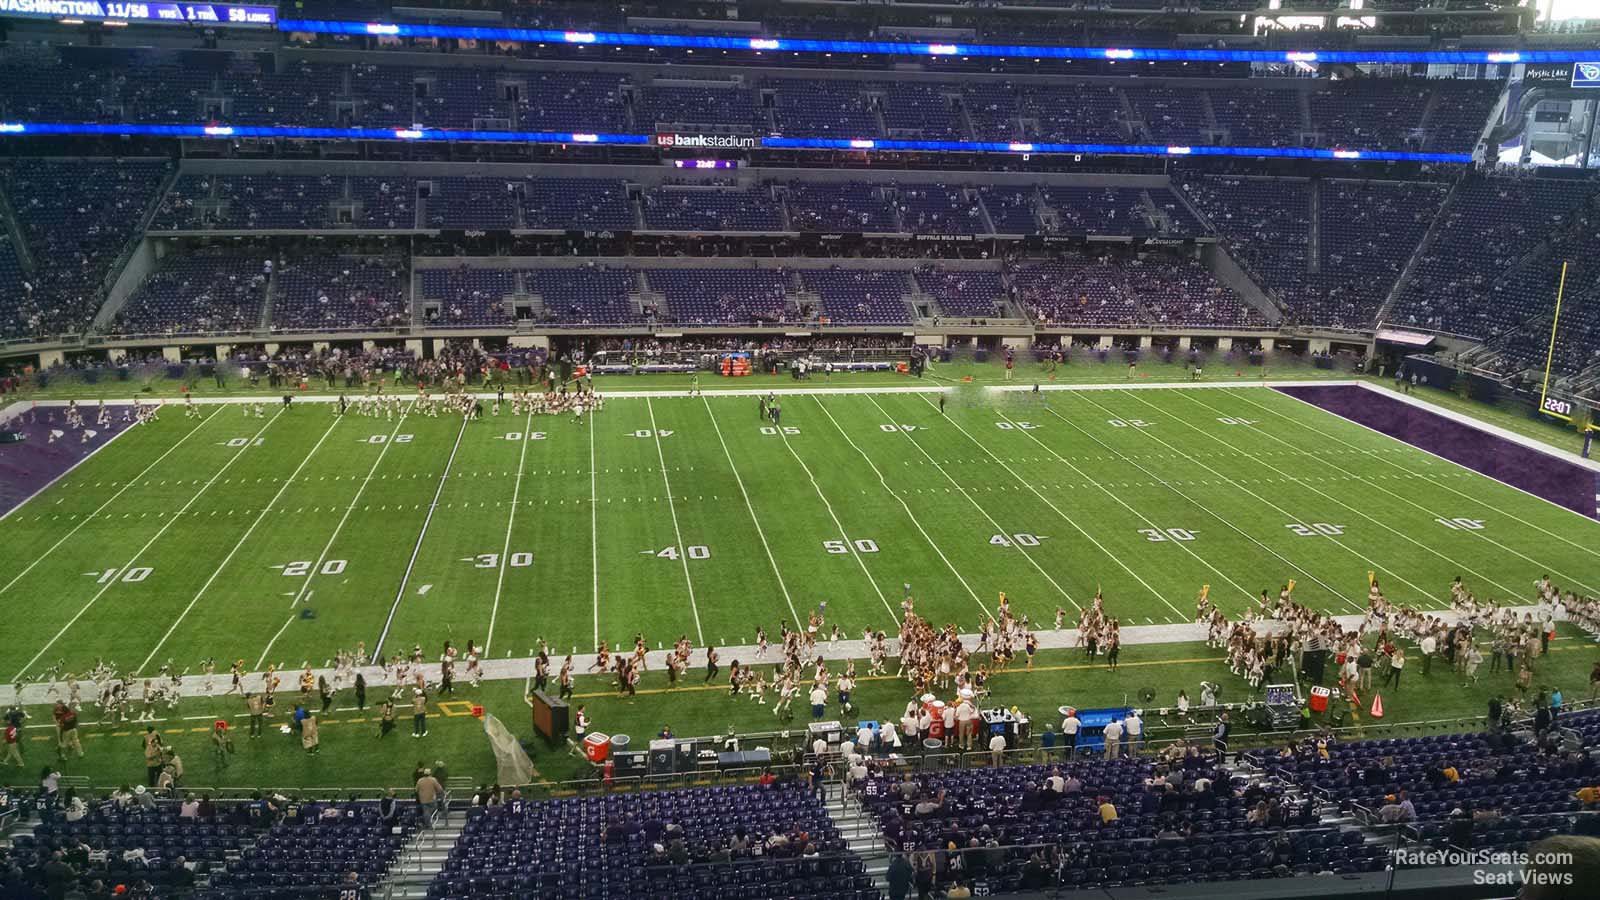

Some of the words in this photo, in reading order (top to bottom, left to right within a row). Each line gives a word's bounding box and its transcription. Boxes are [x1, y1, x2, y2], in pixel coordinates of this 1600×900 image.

[106, 3, 149, 17] 11/58
[187, 7, 196, 19] 1
[229, 9, 245, 21] 58
[247, 13, 270, 22] LONG
[1544, 398, 1571, 414] 22:07
[1284, 523, 1341, 536] 20
[1435, 517, 1479, 530] 10
[988, 533, 1041, 547] 40
[1137, 528, 1196, 542] 30
[656, 545, 711, 560] 40
[822, 539, 880, 554] 50
[474, 552, 534, 568] 30
[96, 567, 155, 583] 10
[281, 560, 347, 577] 20
[929, 722, 941, 734] G
[587, 746, 595, 756] G
[903, 842, 915, 851] 22
